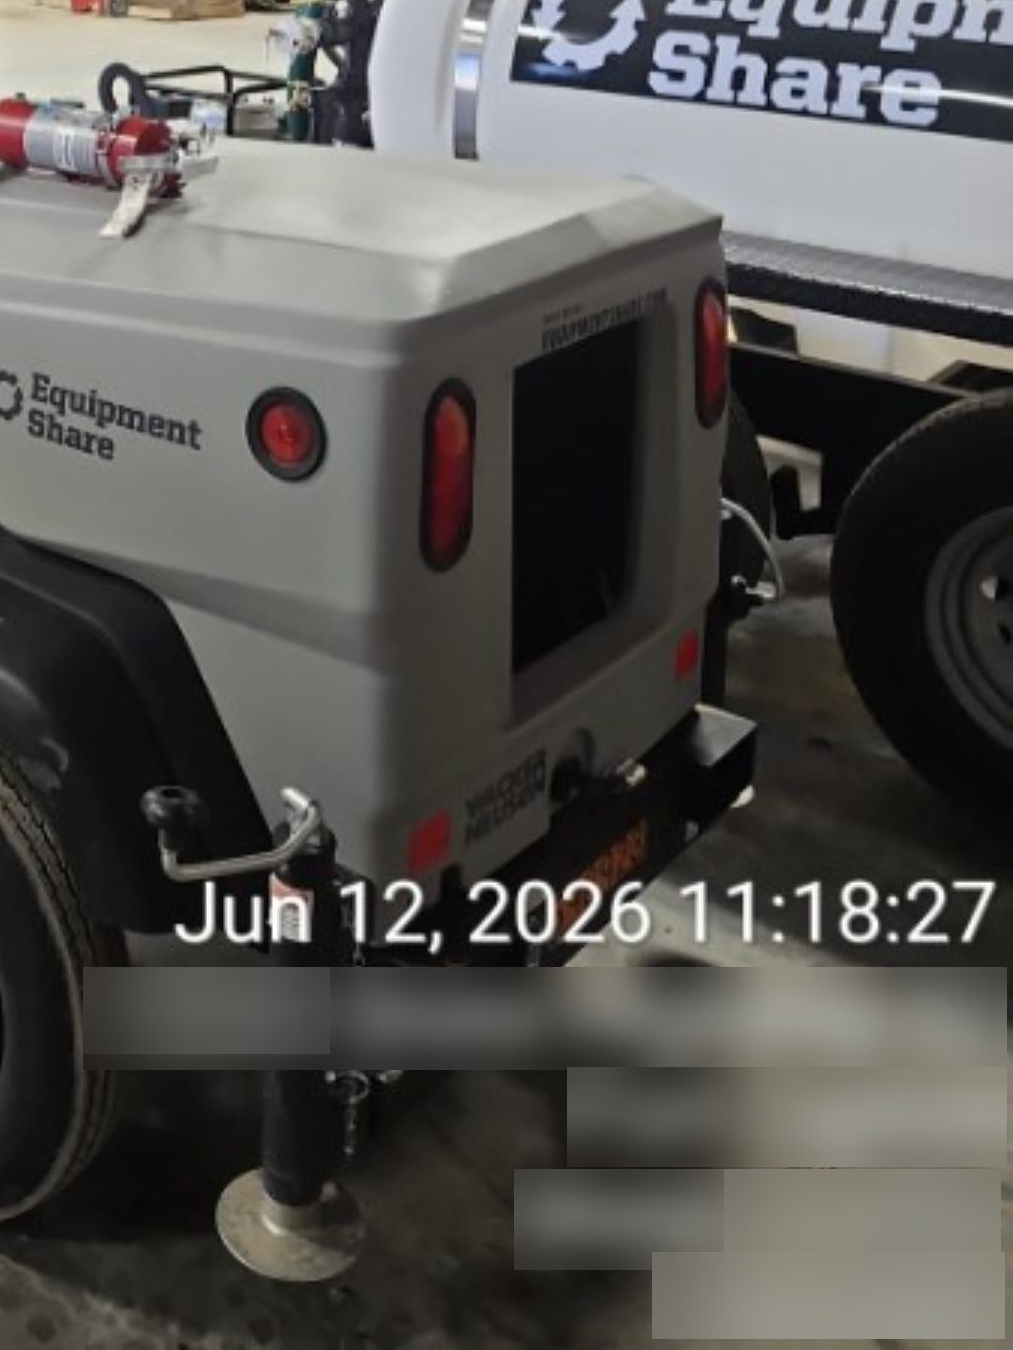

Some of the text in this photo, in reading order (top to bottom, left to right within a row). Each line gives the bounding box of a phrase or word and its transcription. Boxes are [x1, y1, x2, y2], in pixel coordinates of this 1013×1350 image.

[647, 29, 942, 128] Share
[28, 407, 114, 461] Share
[31, 372, 202, 450] Equipment
